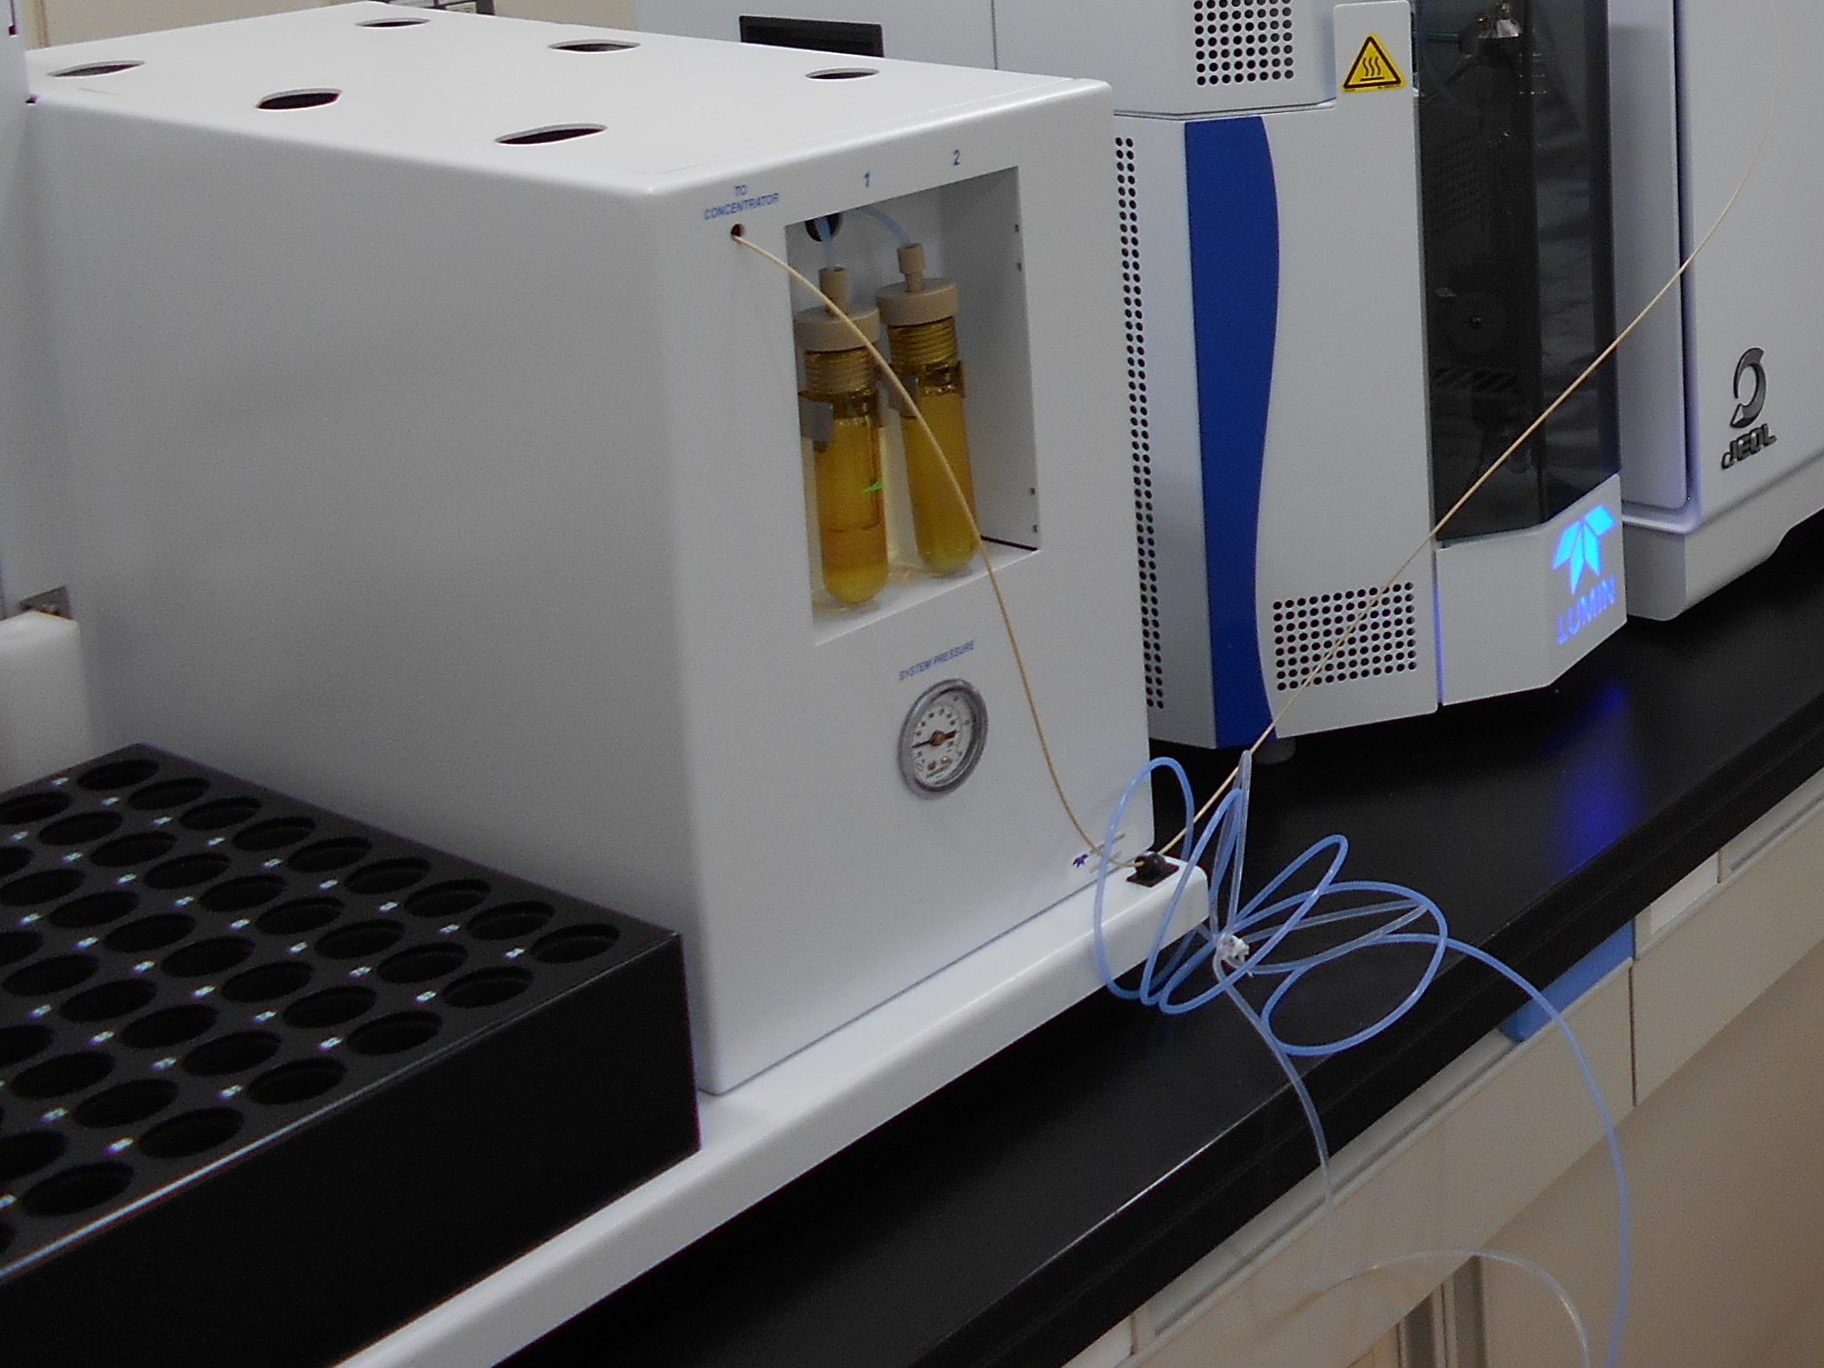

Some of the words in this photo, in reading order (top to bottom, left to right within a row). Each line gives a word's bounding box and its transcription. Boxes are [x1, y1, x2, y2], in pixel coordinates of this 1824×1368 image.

[953, 149, 961, 166] 2
[734, 185, 748, 196] TO
[864, 171, 871, 188] 1
[704, 192, 780, 220] CONCENTRATOR
[1721, 423, 1777, 469] JEOL
[1557, 575, 1616, 645] LUMIN
[899, 658, 932, 681] SYSTEM
[933, 639, 976, 665] PRESSURE
